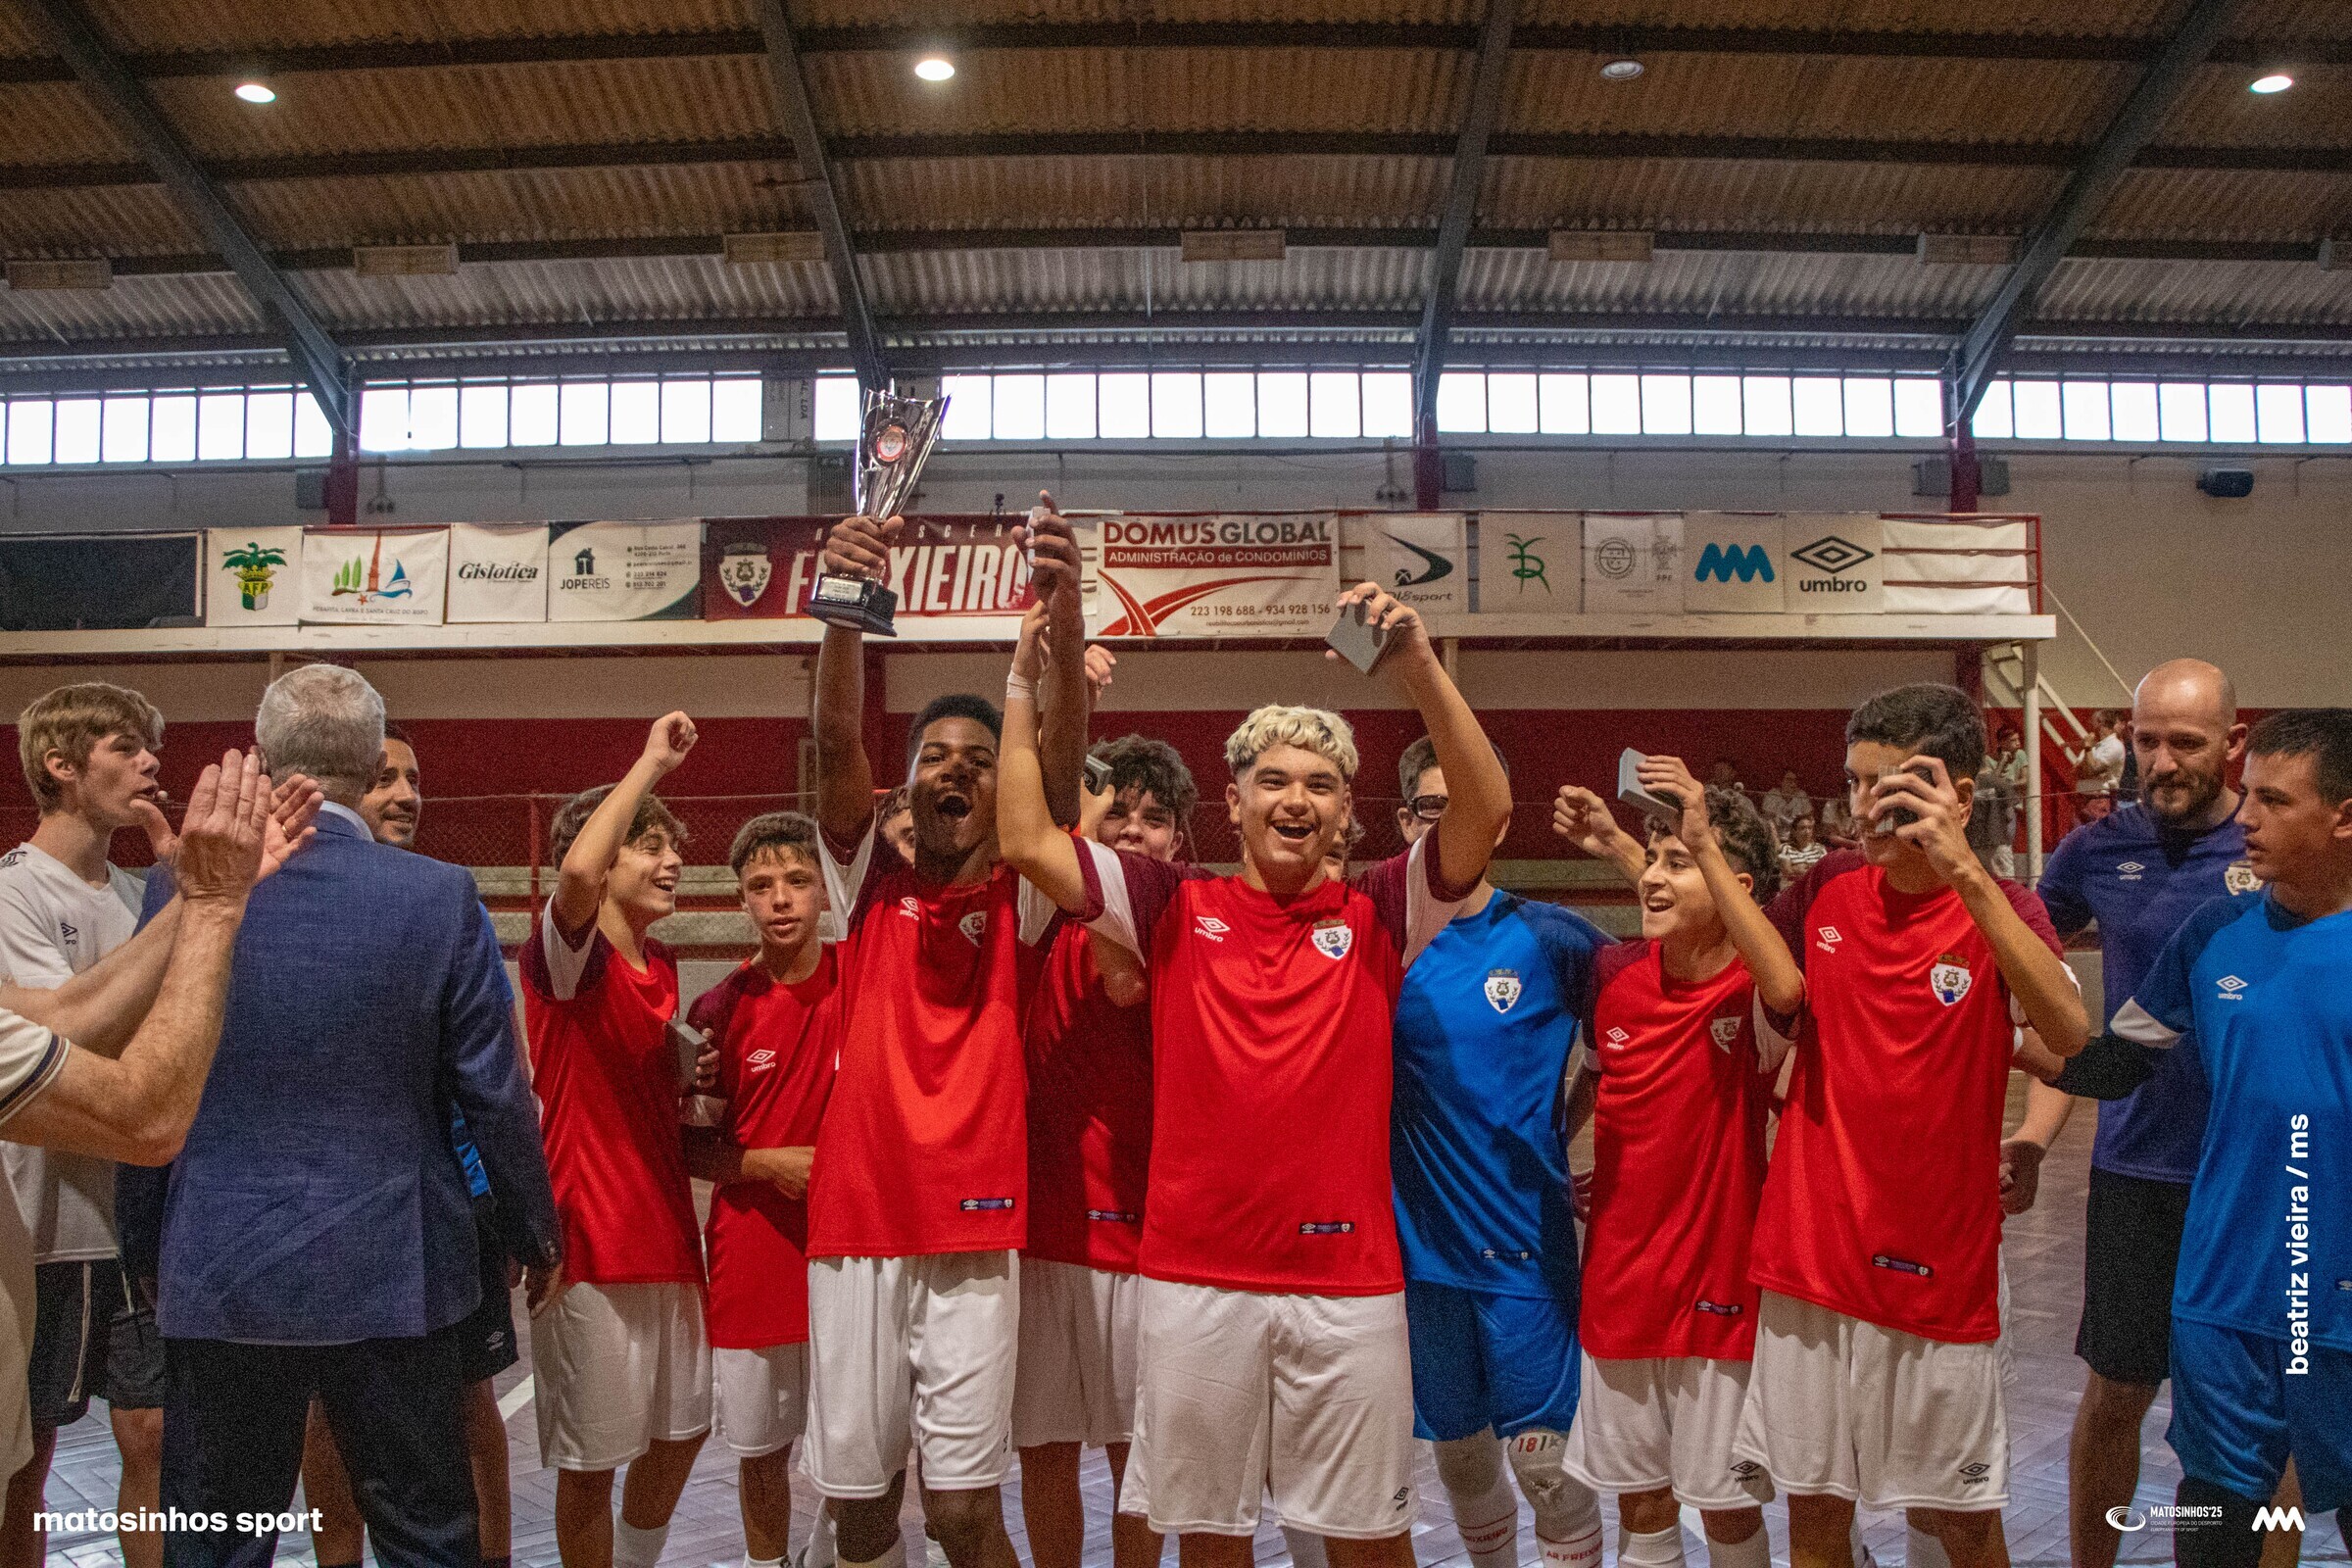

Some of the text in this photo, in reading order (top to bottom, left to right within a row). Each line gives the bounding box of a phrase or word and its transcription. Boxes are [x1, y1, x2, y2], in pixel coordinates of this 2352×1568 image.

[1109, 550, 1215, 564] ADMINISTRAÇÃO
[1218, 551, 1232, 563] de
[459, 561, 538, 580] Gislotica
[561, 578, 611, 590] JOPEREIS
[1799, 575, 1867, 593] umbro
[1191, 606, 1209, 615] 223
[1214, 606, 1233, 615] 198
[1236, 606, 1254, 615] 688
[1265, 605, 1285, 614] 934
[1289, 605, 1307, 614] 928
[1312, 604, 1330, 614] 156
[1195, 926, 1224, 943] umbro
[2218, 992, 2243, 1001] umbro
[751, 1060, 776, 1073] umbro
[1963, 1476, 1989, 1485] umbro
